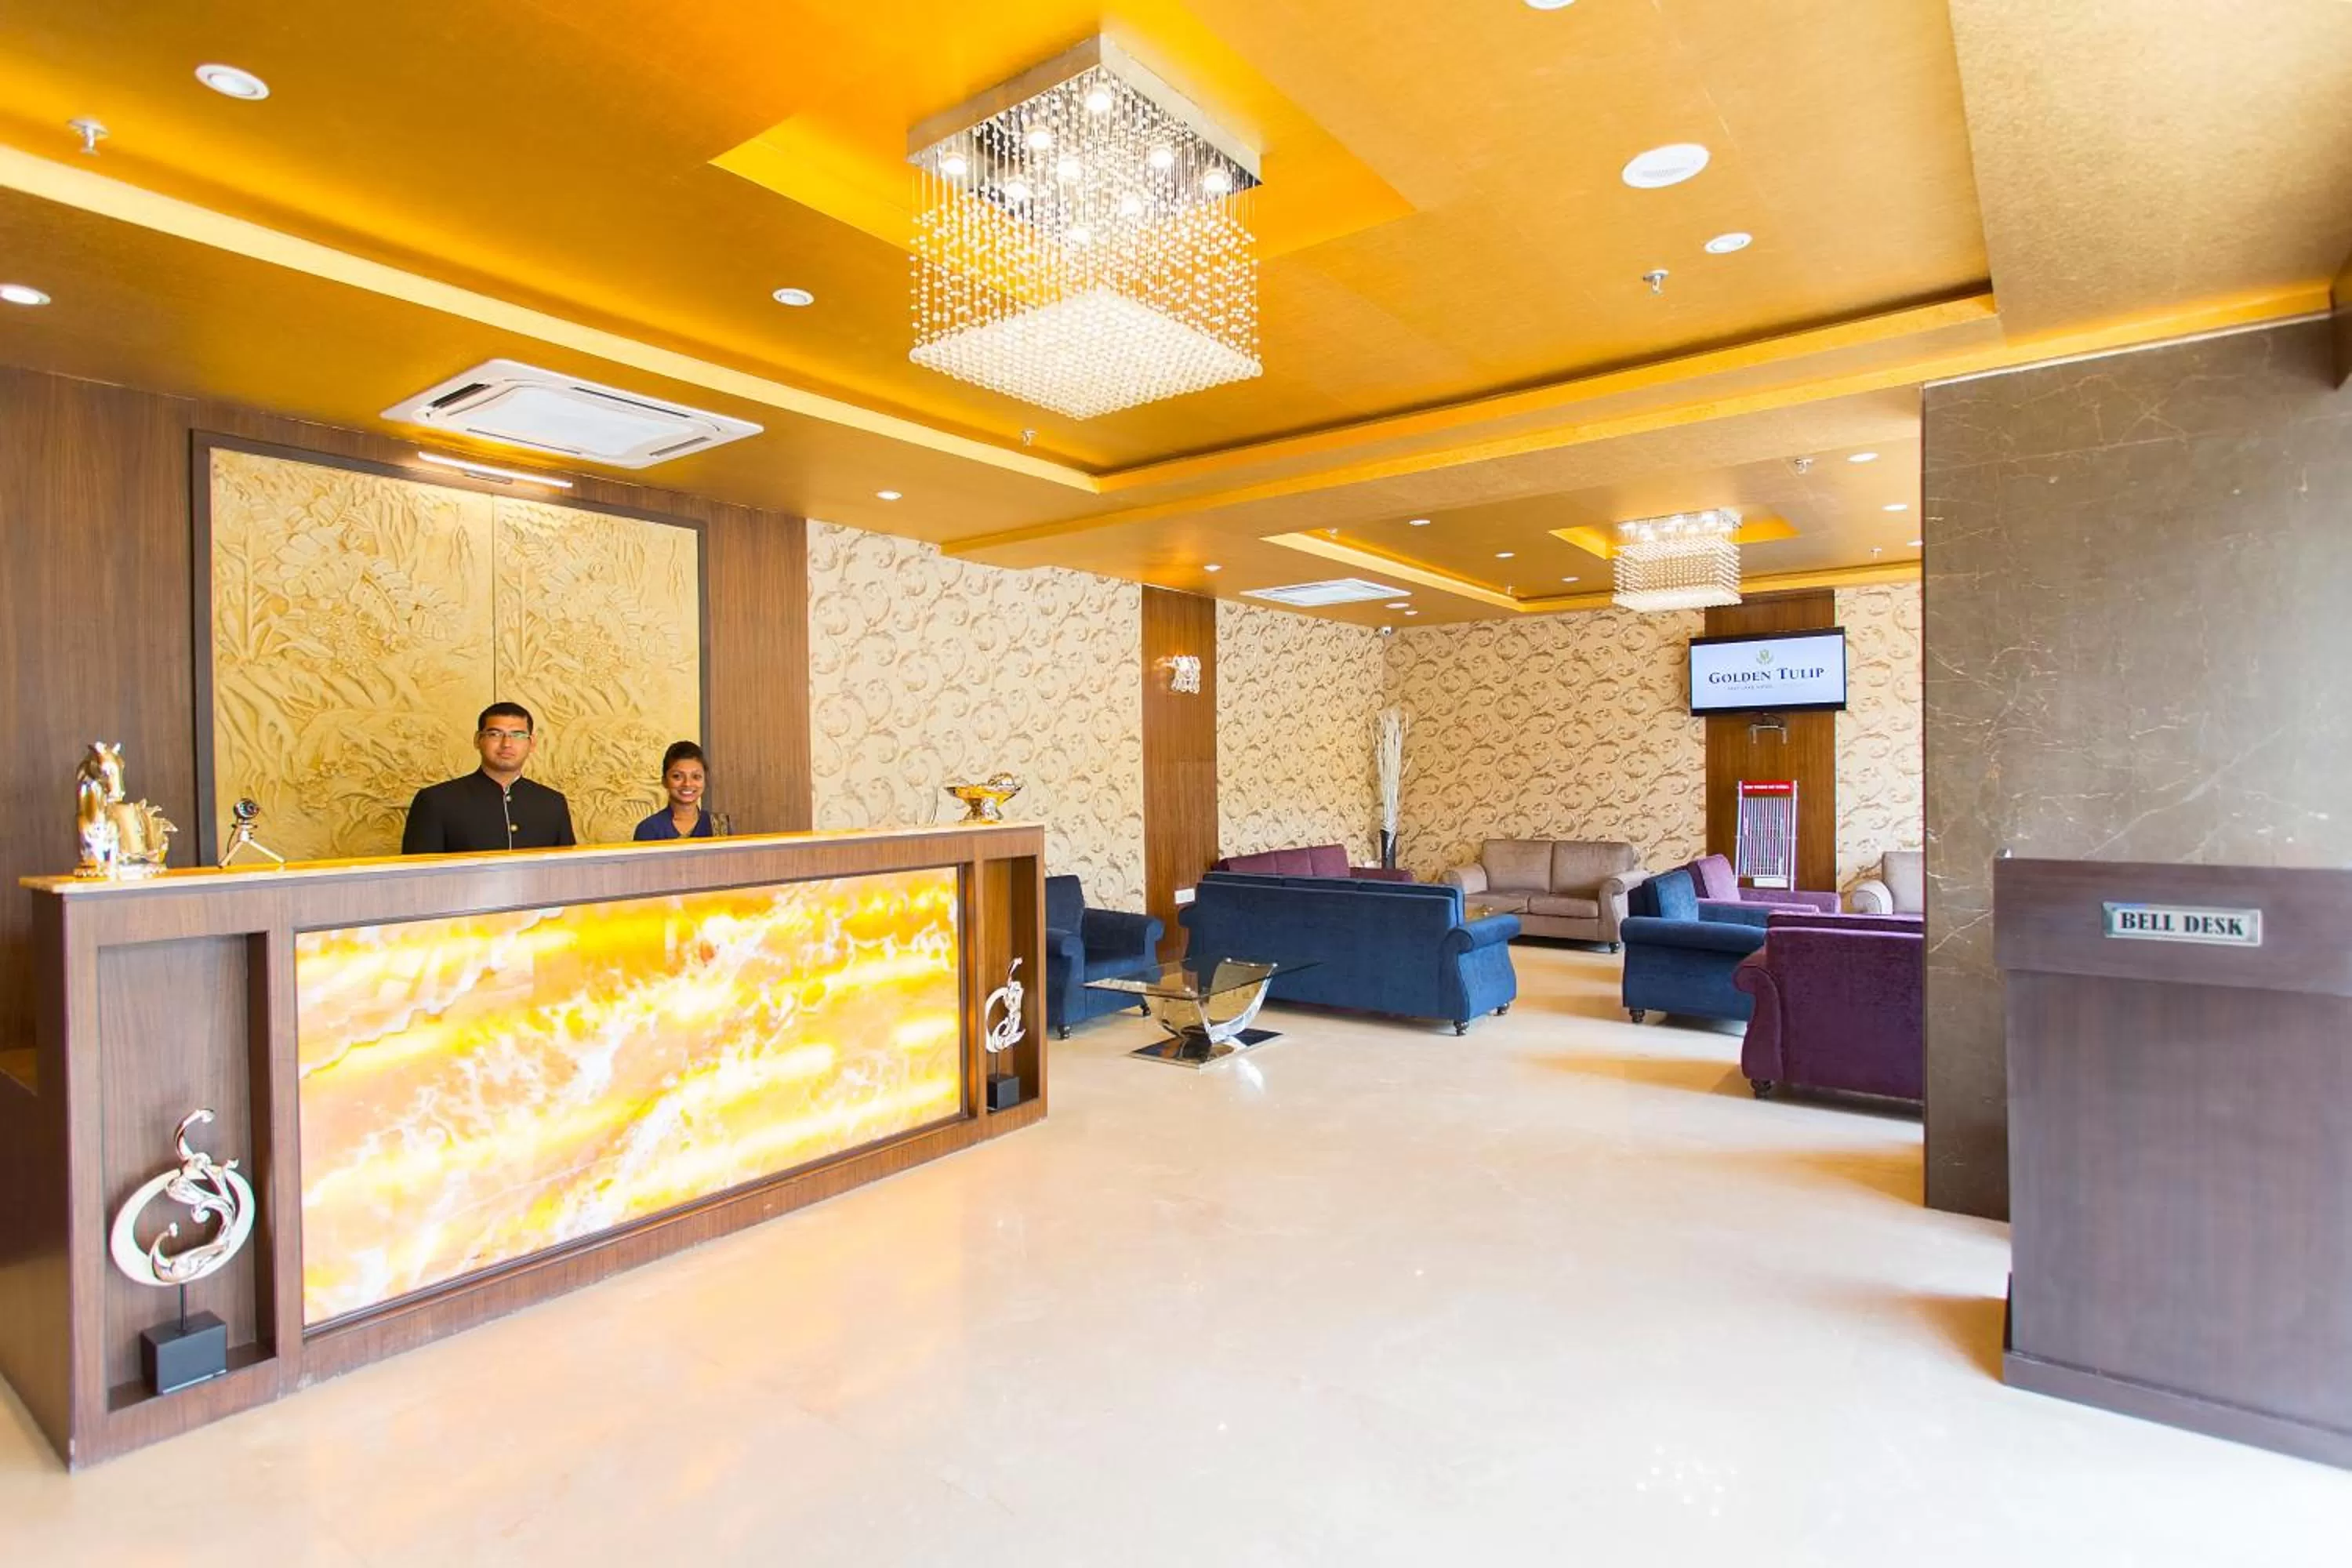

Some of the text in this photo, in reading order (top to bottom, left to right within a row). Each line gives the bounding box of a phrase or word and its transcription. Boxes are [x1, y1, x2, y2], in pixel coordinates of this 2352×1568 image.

[1708, 667, 1825, 684] GOLDEN TULIP
[2120, 912, 2244, 936] BELL DESK
